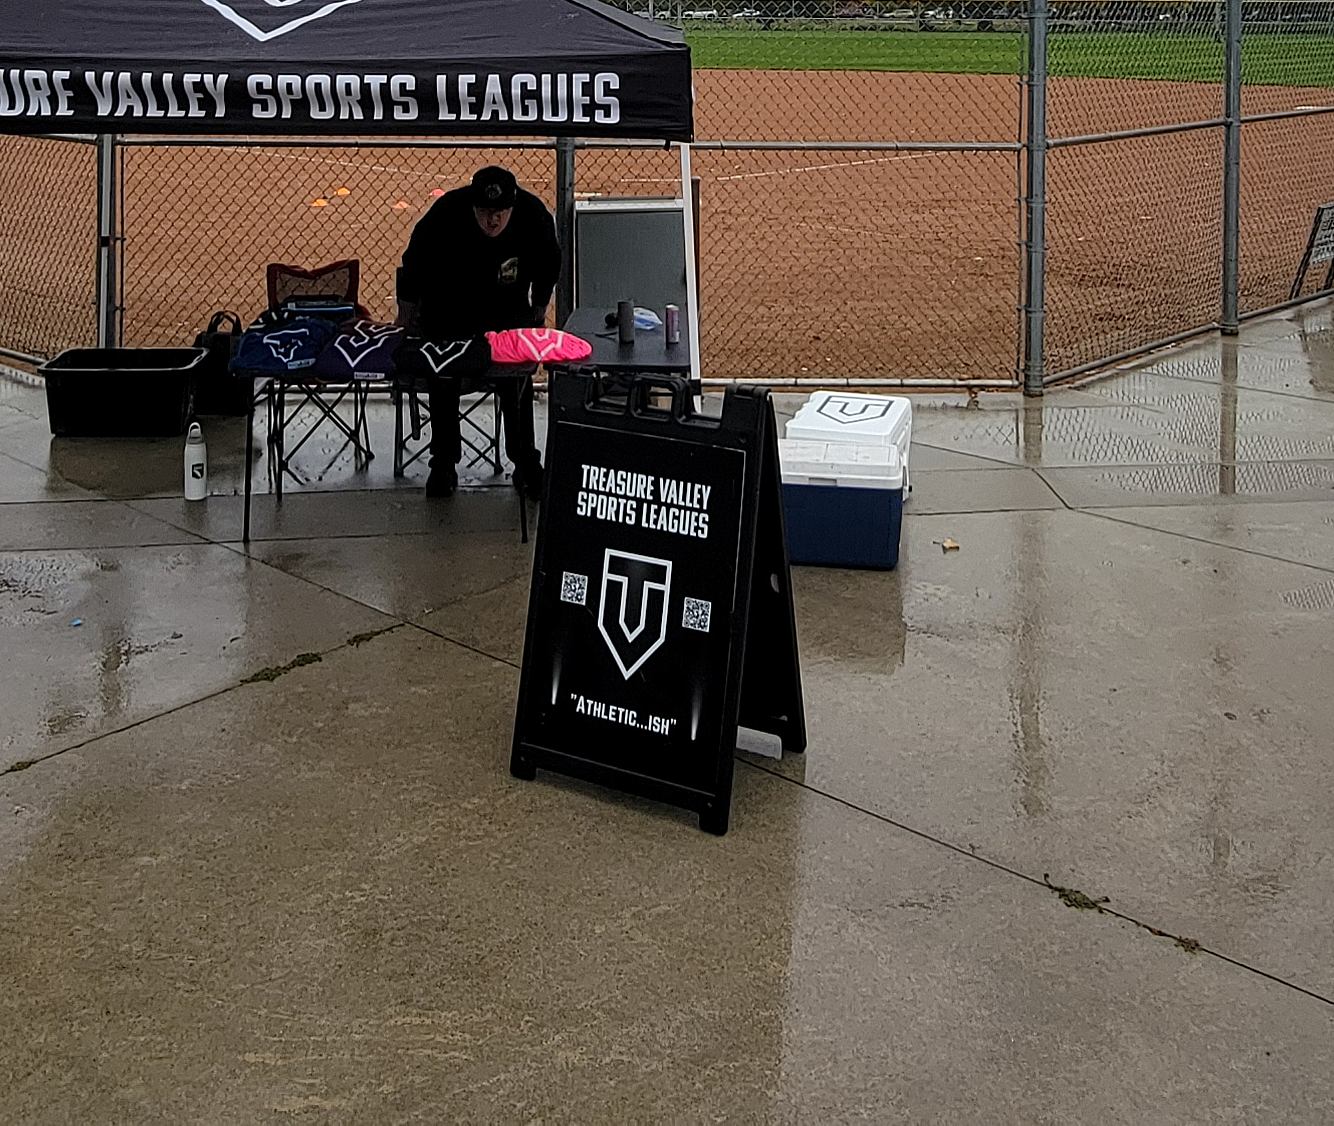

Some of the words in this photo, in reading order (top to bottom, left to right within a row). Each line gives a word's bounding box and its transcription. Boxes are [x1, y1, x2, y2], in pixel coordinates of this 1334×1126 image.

[84, 70, 230, 119] VALLEY
[246, 73, 420, 121] SPORTS
[435, 72, 622, 124] LEAGUES
[581, 464, 655, 501] TREASURE
[659, 477, 712, 511] VALLEY
[576, 490, 637, 526] SPORTS
[641, 502, 709, 539] LEAGUES
